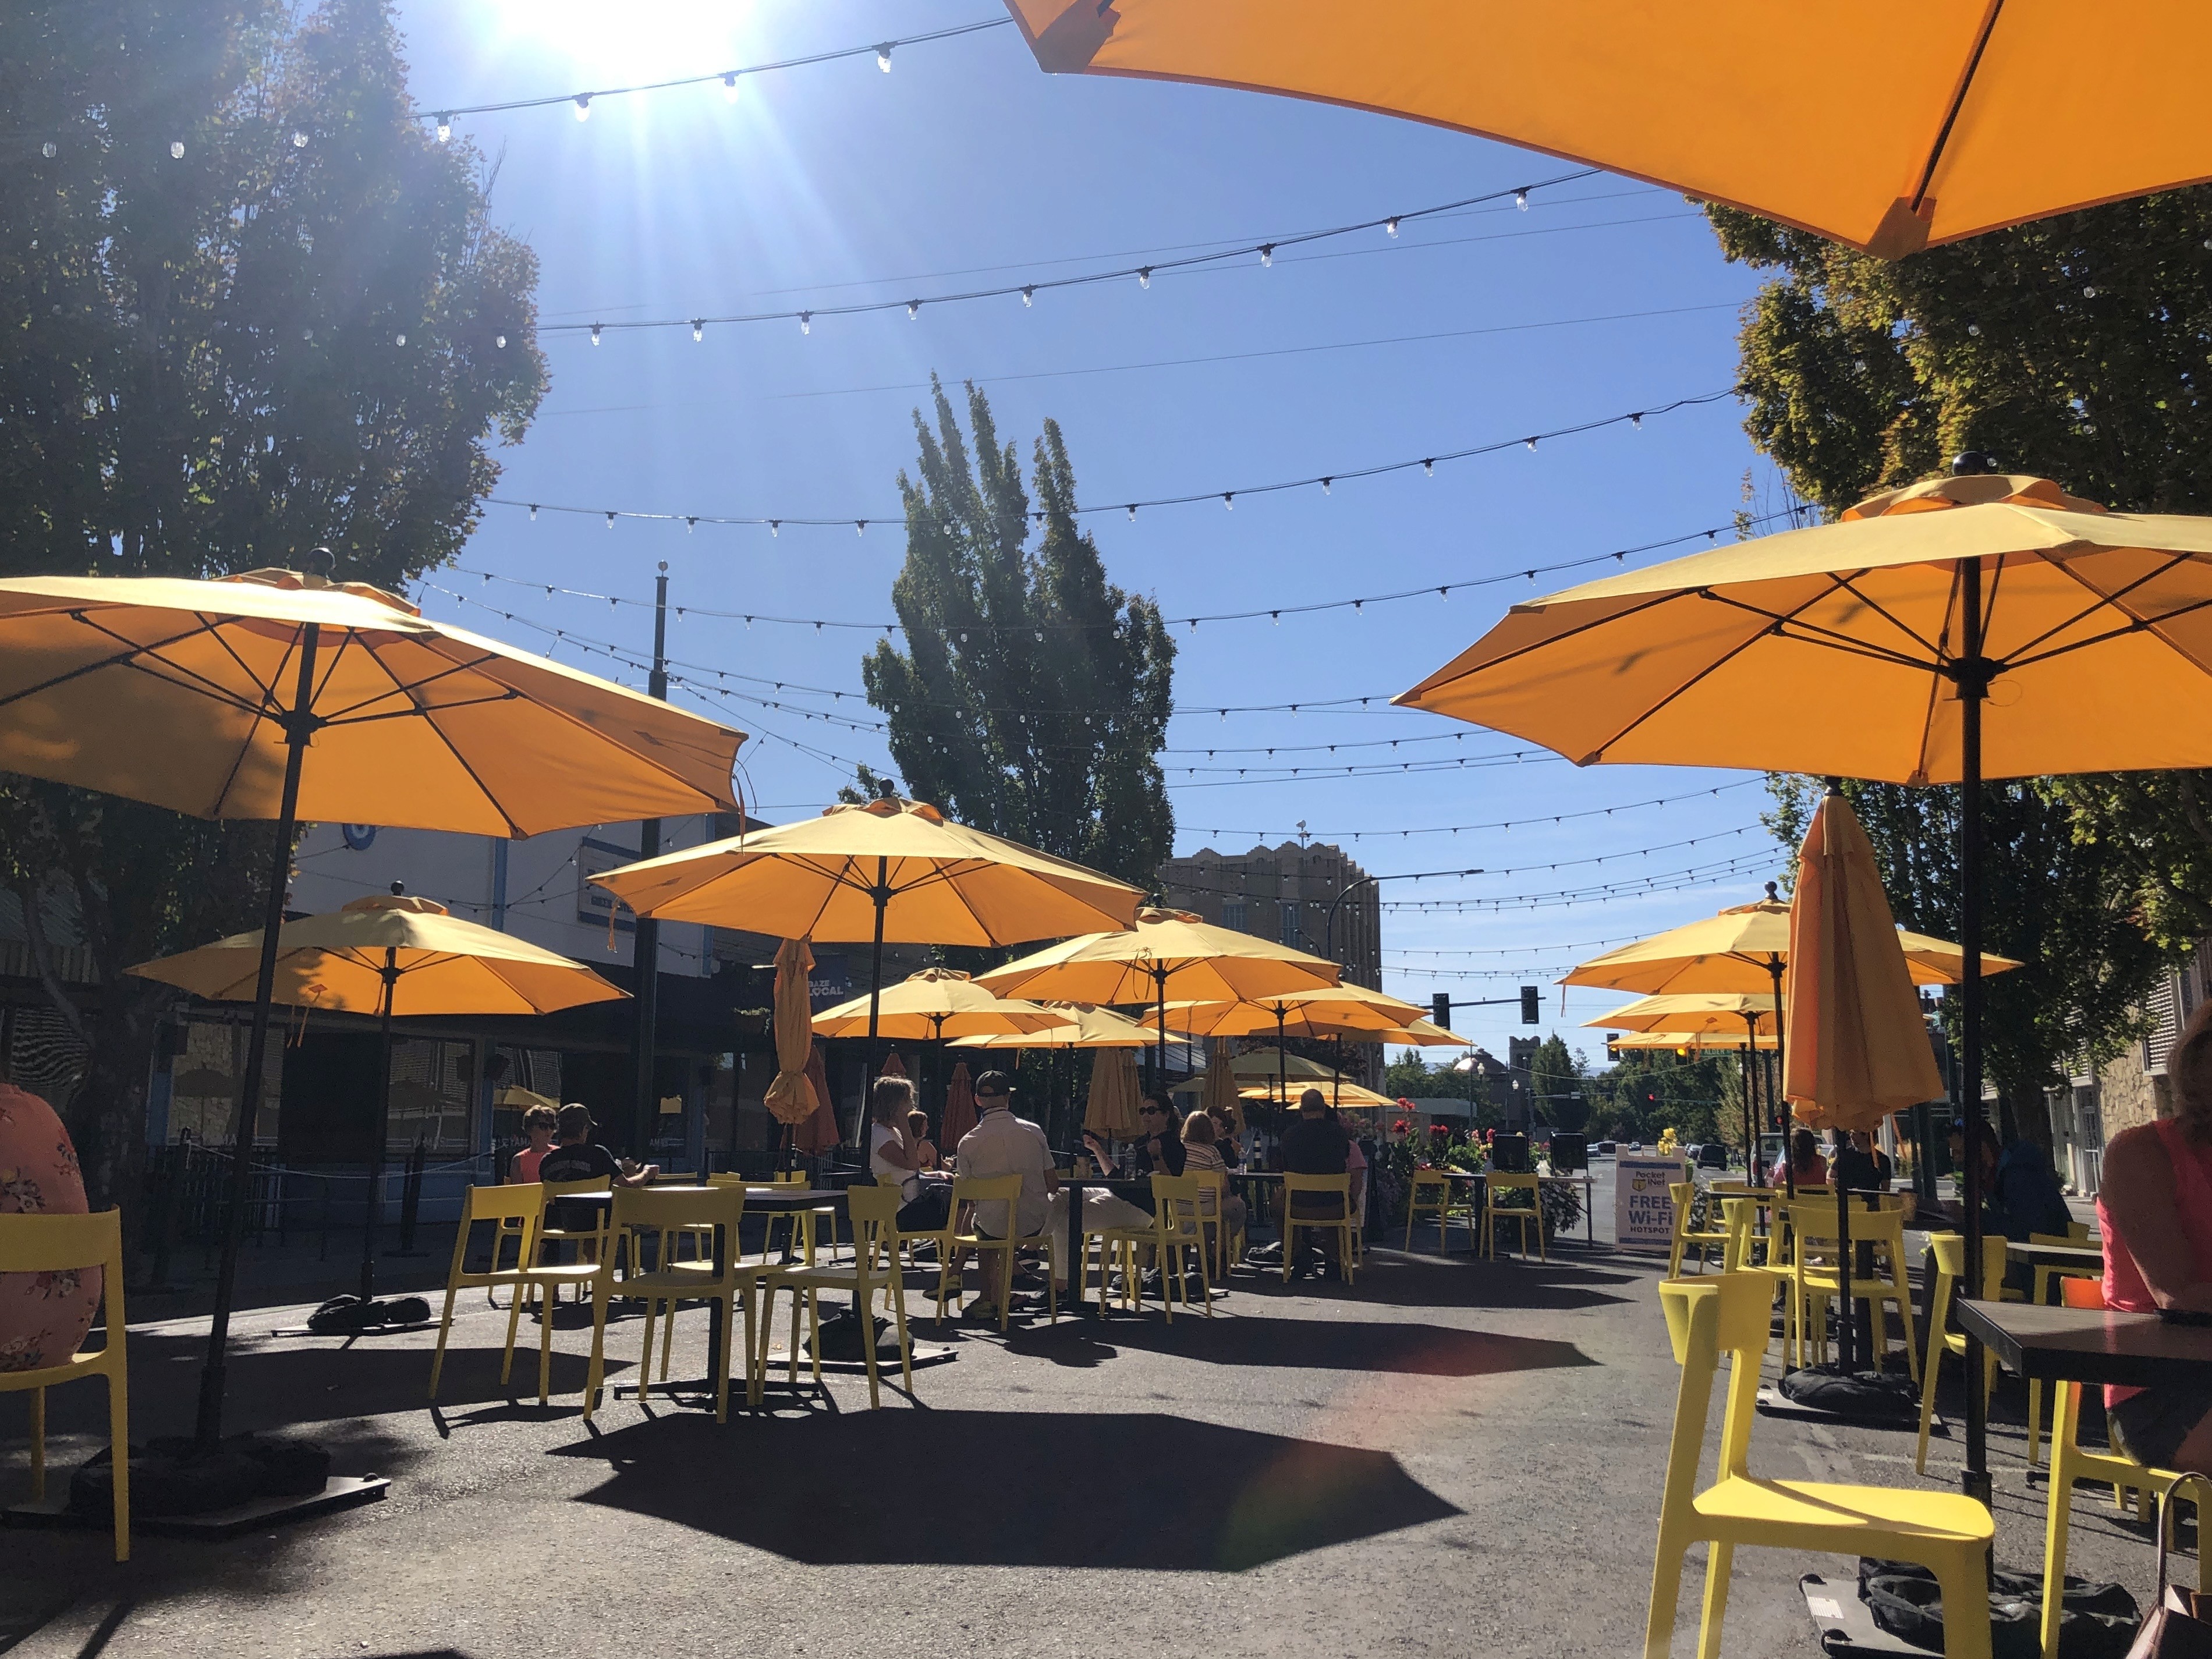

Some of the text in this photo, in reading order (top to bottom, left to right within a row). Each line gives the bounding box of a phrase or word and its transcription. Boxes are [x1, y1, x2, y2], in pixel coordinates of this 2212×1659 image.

[809, 986, 844, 997] LOCAL
[1630, 1195, 1671, 1209] FREE
[1628, 1210, 1673, 1225] Wi-Fi
